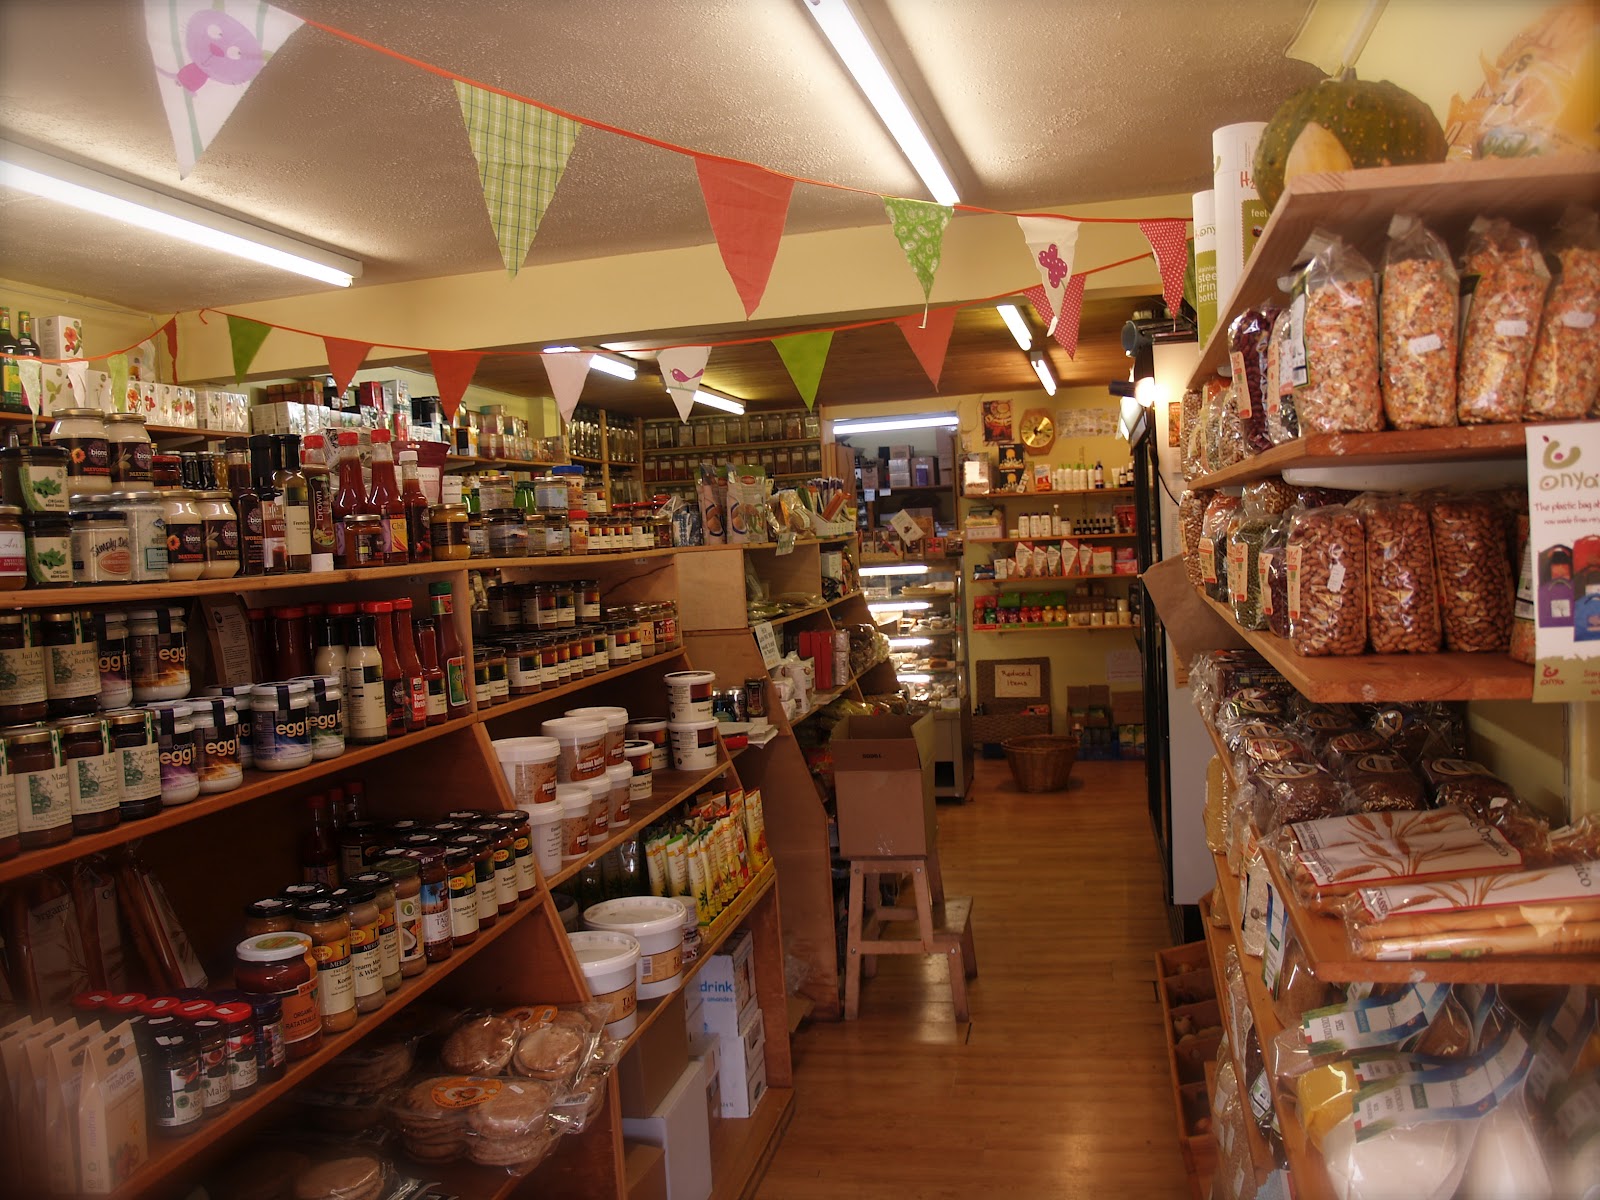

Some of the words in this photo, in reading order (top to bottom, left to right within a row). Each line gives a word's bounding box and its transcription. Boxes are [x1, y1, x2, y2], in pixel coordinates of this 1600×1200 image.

[1251, 208, 1267, 218] feel
[1198, 272, 1217, 283] stee
[1198, 282, 1216, 293] drin
[1199, 292, 1217, 303] bottl
[315, 490, 324, 520] brown
[1534, 502, 1550, 511] The
[1551, 502, 1576, 513] plastic
[1578, 500, 1592, 511] bag
[159, 647, 187, 662] egg
[1001, 668, 1032, 677] Reduced
[700, 981, 733, 993] drink
[293, 1007, 313, 1018] ORGANIC
[285, 1014, 317, 1029] RATATOUILLE
[109, 1069, 134, 1091] madras
